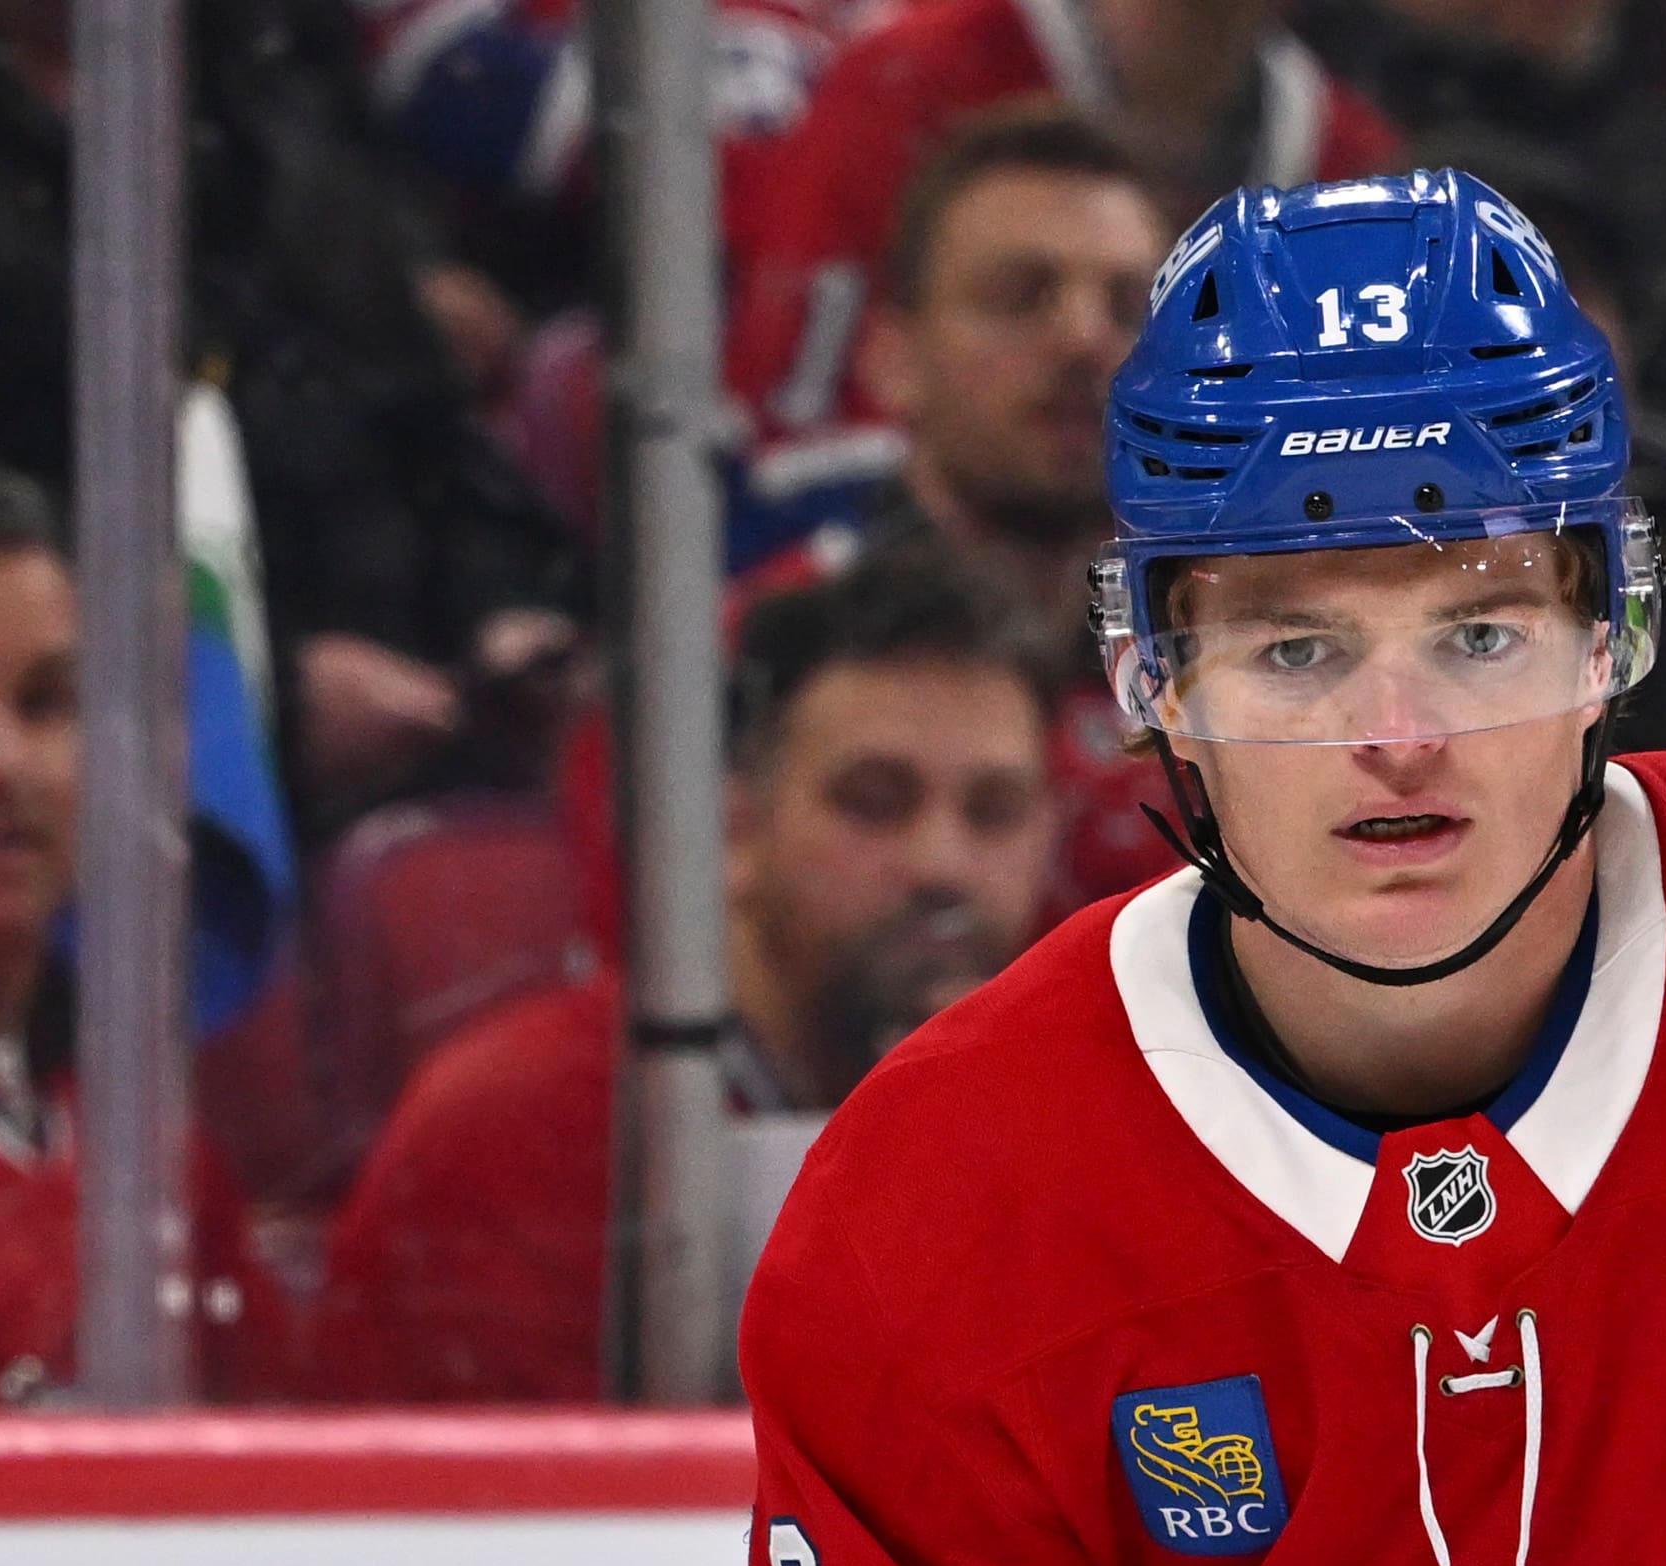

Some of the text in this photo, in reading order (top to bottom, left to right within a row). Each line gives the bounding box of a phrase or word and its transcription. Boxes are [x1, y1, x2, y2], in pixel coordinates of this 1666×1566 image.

[1316, 284, 1409, 347] 13
[1428, 1164, 1474, 1226] LNH
[1158, 1502, 1271, 1538] RBC
